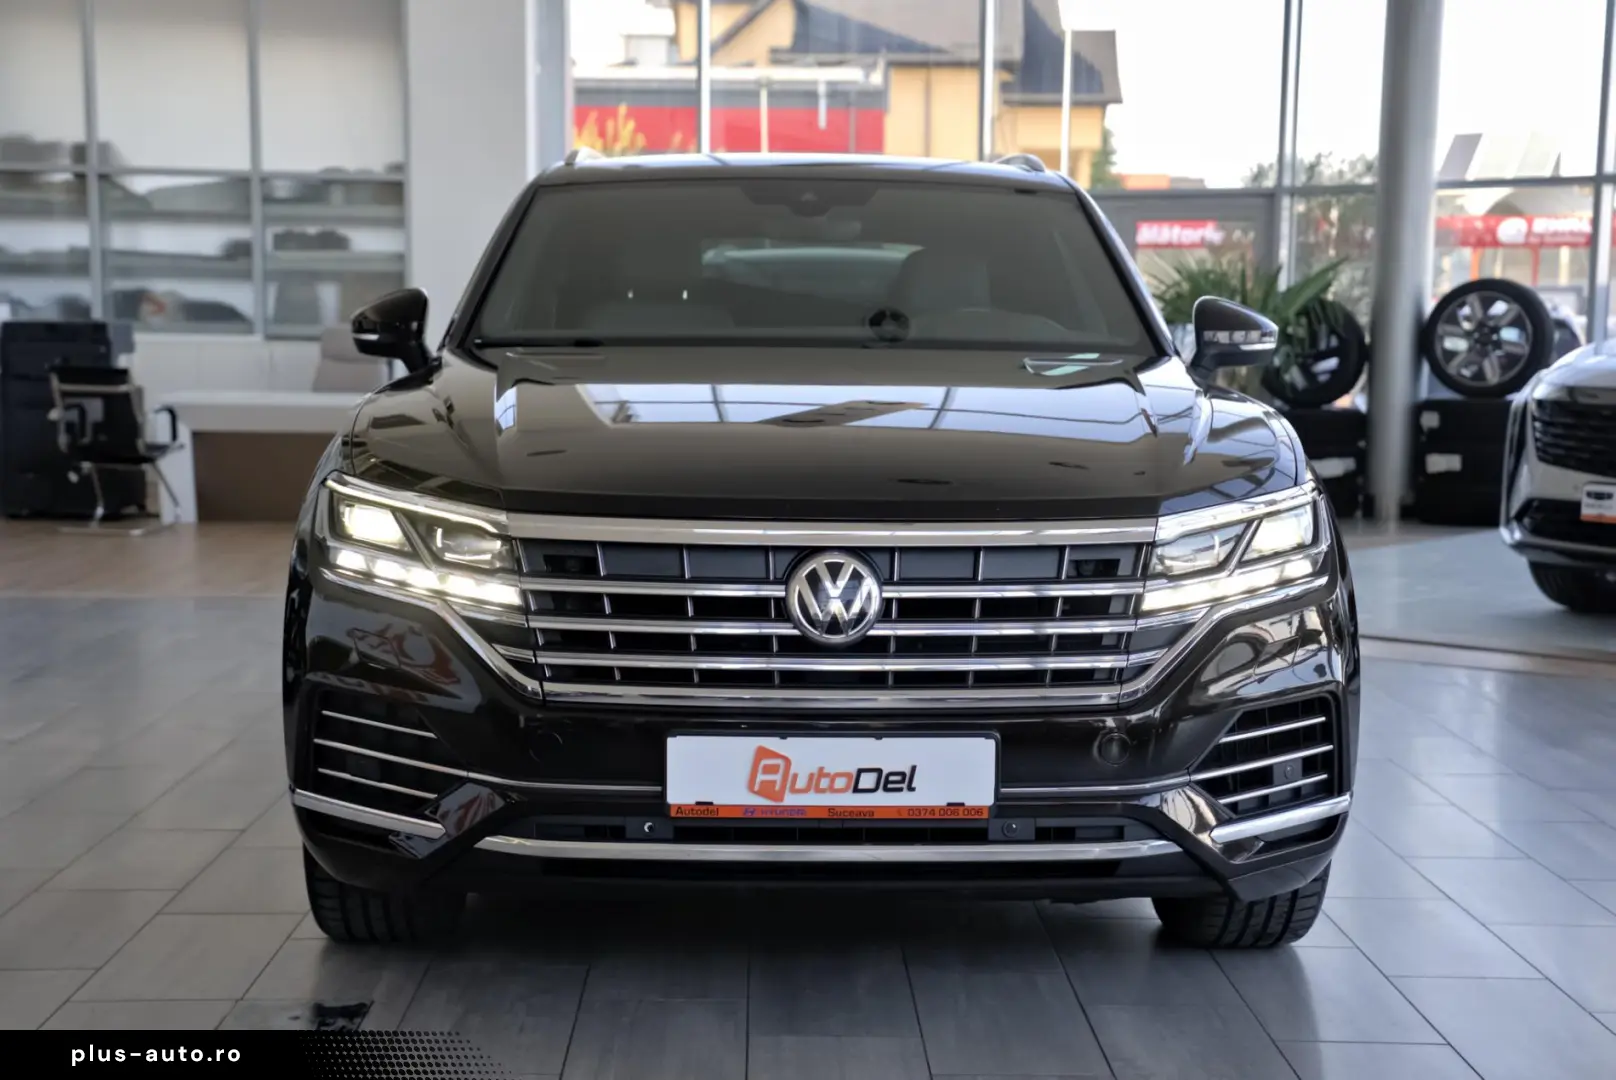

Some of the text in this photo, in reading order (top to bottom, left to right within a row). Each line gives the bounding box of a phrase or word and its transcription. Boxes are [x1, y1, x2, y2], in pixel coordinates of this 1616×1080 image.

[751, 753, 917, 797] AutoDel
[675, 806, 719, 817] Autodel
[828, 807, 875, 817] Suceava
